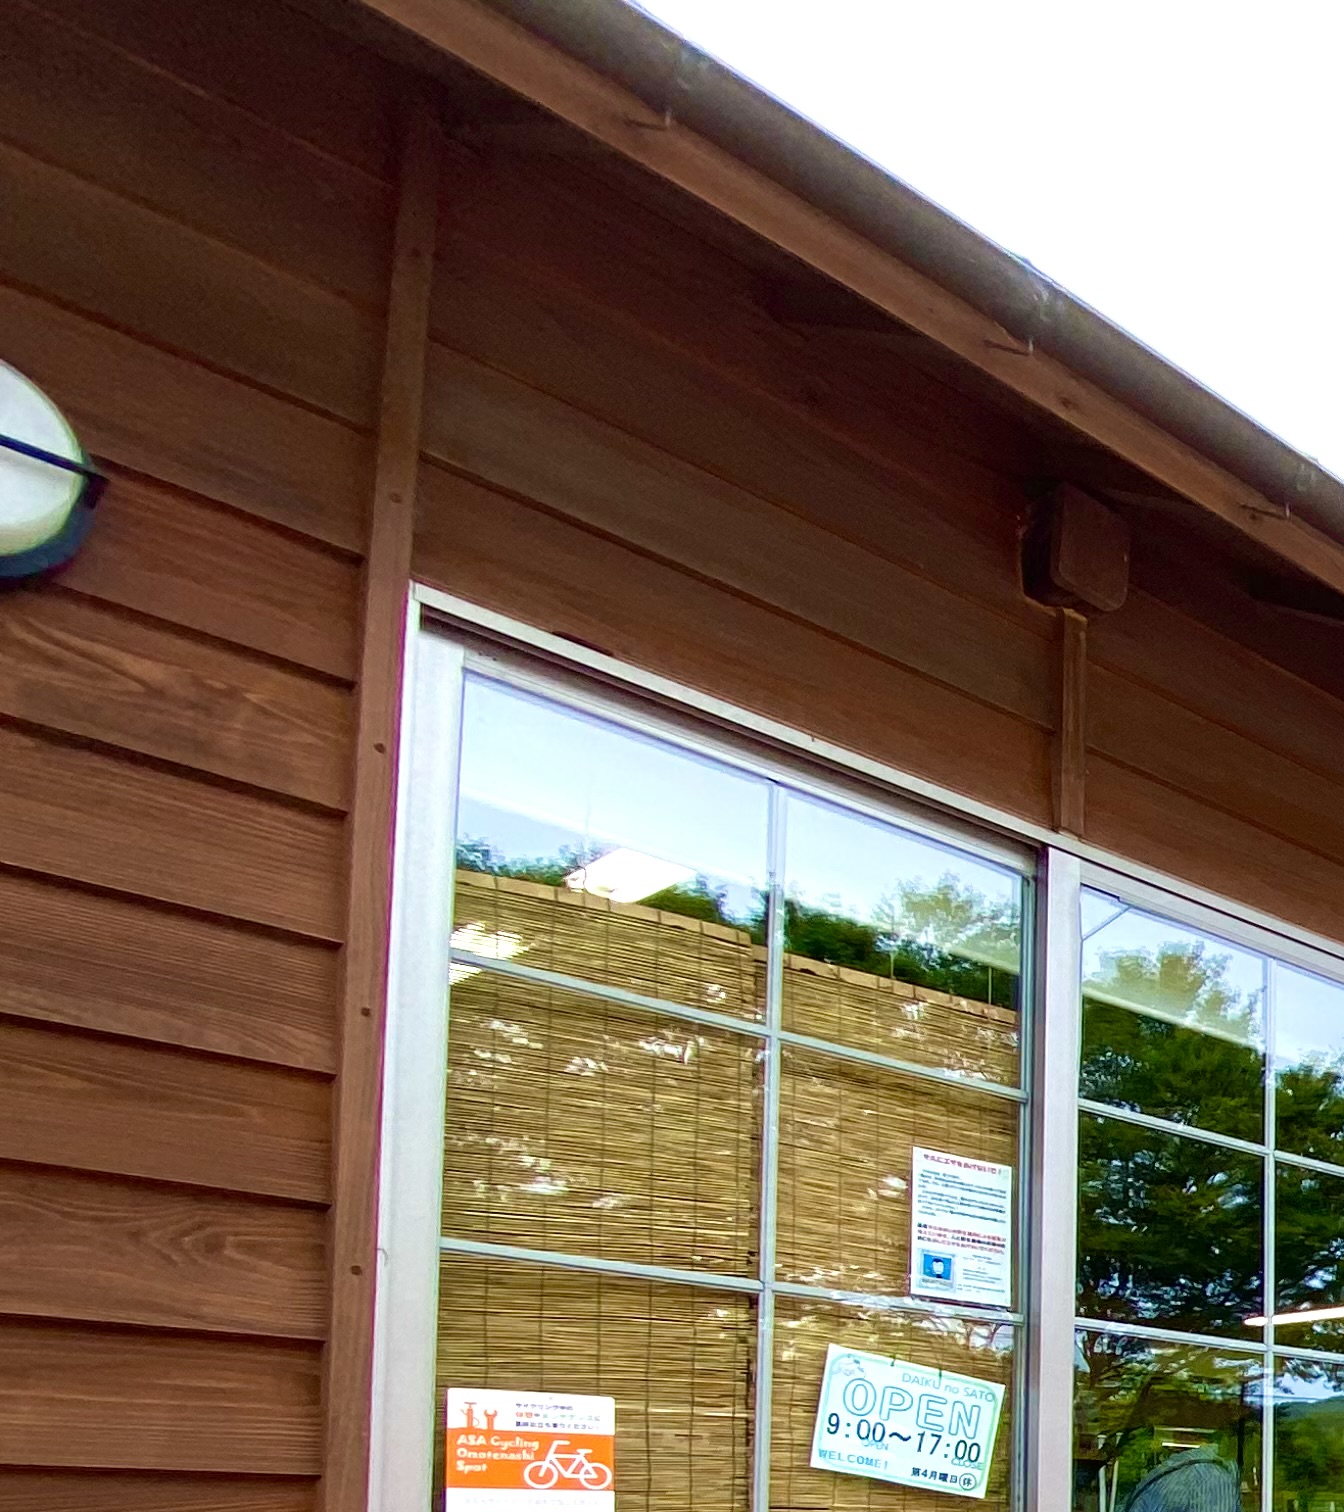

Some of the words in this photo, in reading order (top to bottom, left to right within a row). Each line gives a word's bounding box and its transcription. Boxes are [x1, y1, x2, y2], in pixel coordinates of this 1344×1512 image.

[902, 1373, 941, 1390] DAIKU
[944, 1384, 960, 1394] no
[962, 1387, 996, 1403] SATO
[843, 1378, 981, 1440] OPEN
[456, 1433, 487, 1446] ASA
[490, 1436, 540, 1451] Cycling
[456, 1448, 535, 1461] Omotenashi
[456, 1460, 487, 1475] Spot
